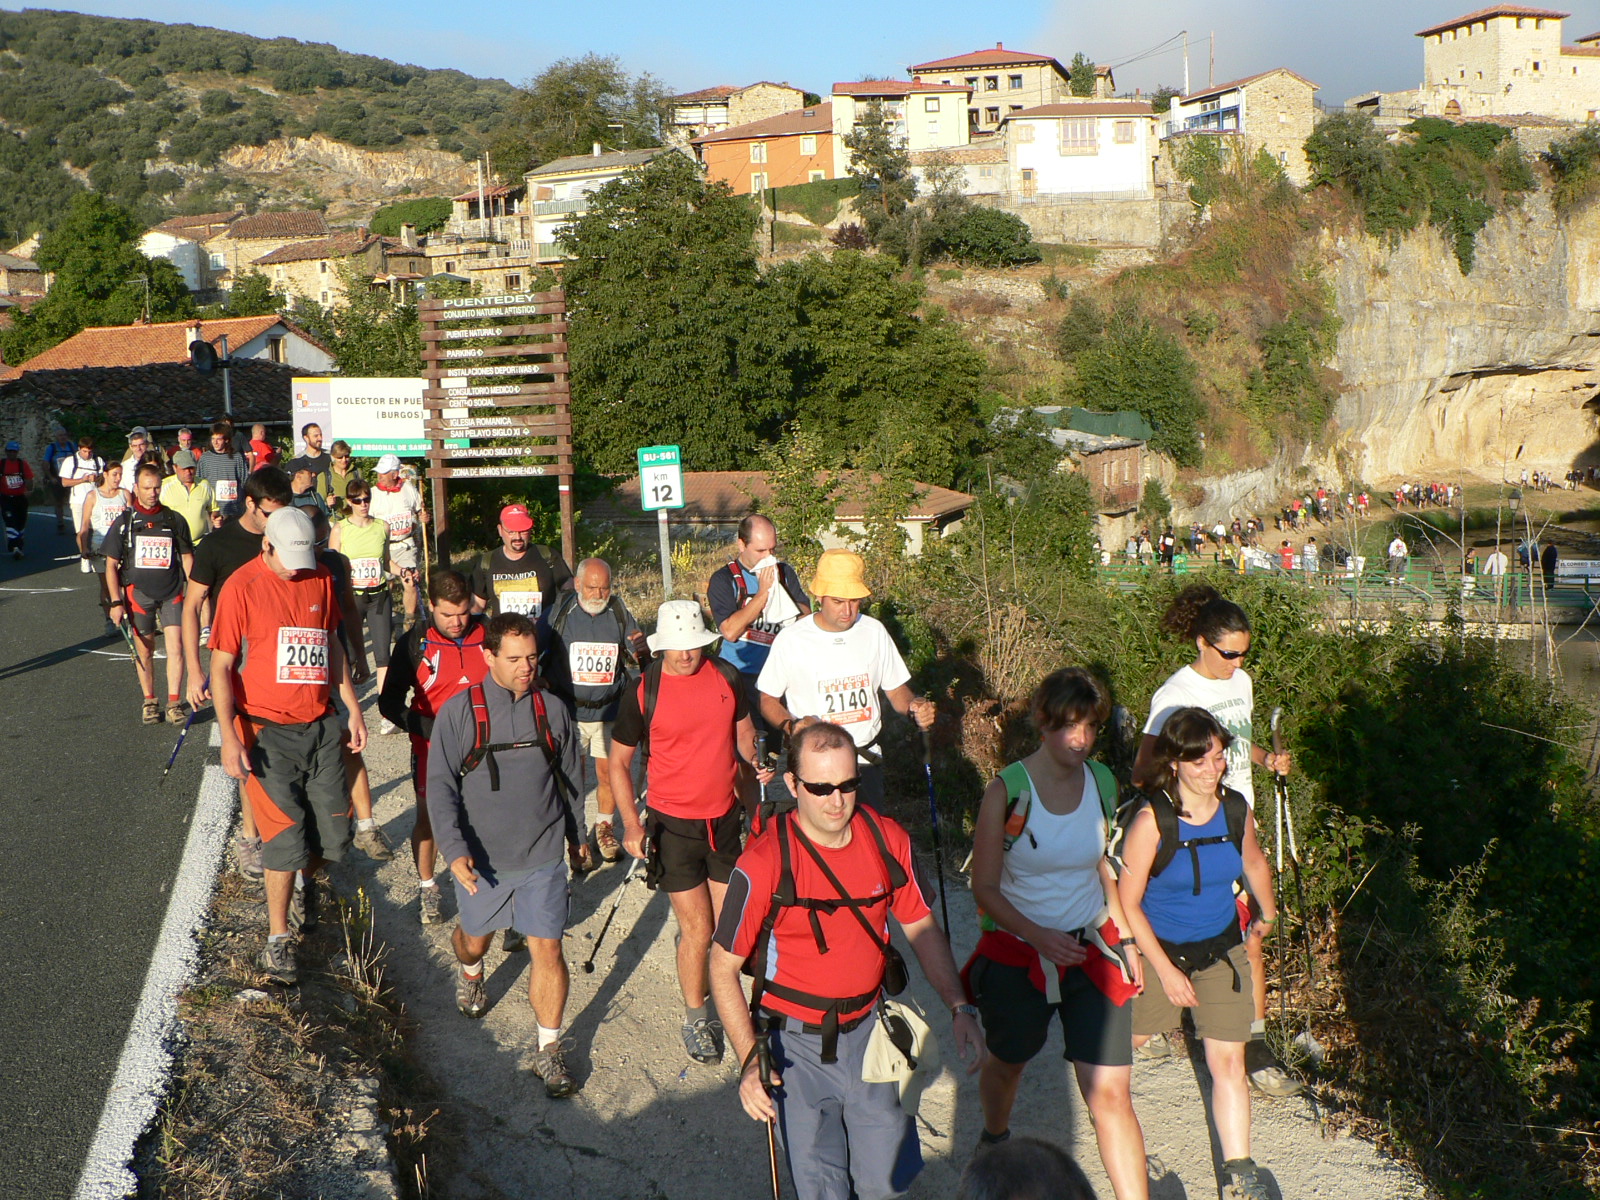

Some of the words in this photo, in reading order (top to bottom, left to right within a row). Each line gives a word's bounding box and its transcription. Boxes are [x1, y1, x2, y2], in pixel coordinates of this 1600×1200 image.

[444, 294, 536, 307] PUENTEDEY
[444, 308, 475, 319] CONJUNTO
[476, 306, 503, 317] NATURAL
[504, 305, 536, 316] ARTISTICO
[446, 330, 468, 338] PUENTE
[470, 328, 496, 338] NATURAL
[447, 349, 476, 358] PARKING
[448, 367, 494, 376] INSTALACIONES
[494, 365, 532, 374] DEPORTIVAS
[448, 386, 490, 396] CONSULTORIO
[404, 397, 422, 405] PUE
[449, 400, 472, 408] CENTRO
[474, 398, 496, 406] SOCIAL
[376, 411, 424, 420] (BURGOS)
[450, 418, 475, 427] IGLESIA
[450, 430, 464, 438] SAN
[465, 428, 491, 438] PELAYO
[492, 428, 512, 436] SIGLO
[514, 428, 520, 436] XI
[452, 448, 468, 457] CASA
[468, 448, 494, 456] PALACIO
[494, 446, 514, 456] SIGLO
[514, 446, 522, 454] XV
[452, 468, 468, 476] ZONA
[470, 468, 480, 476] DE
[480, 466, 500, 476] BAÑOS
[500, 467, 506, 475] Y
[506, 466, 536, 475] MERIENDA
[654, 473, 668, 481] km
[652, 484, 673, 502] 12
[142, 546, 168, 558] 2133
[351, 568, 376, 578] 2130
[492, 570, 536, 580] LEONARDO
[286, 645, 324, 666] 2066
[577, 656, 612, 672] 2068
[826, 688, 868, 714] 2140
